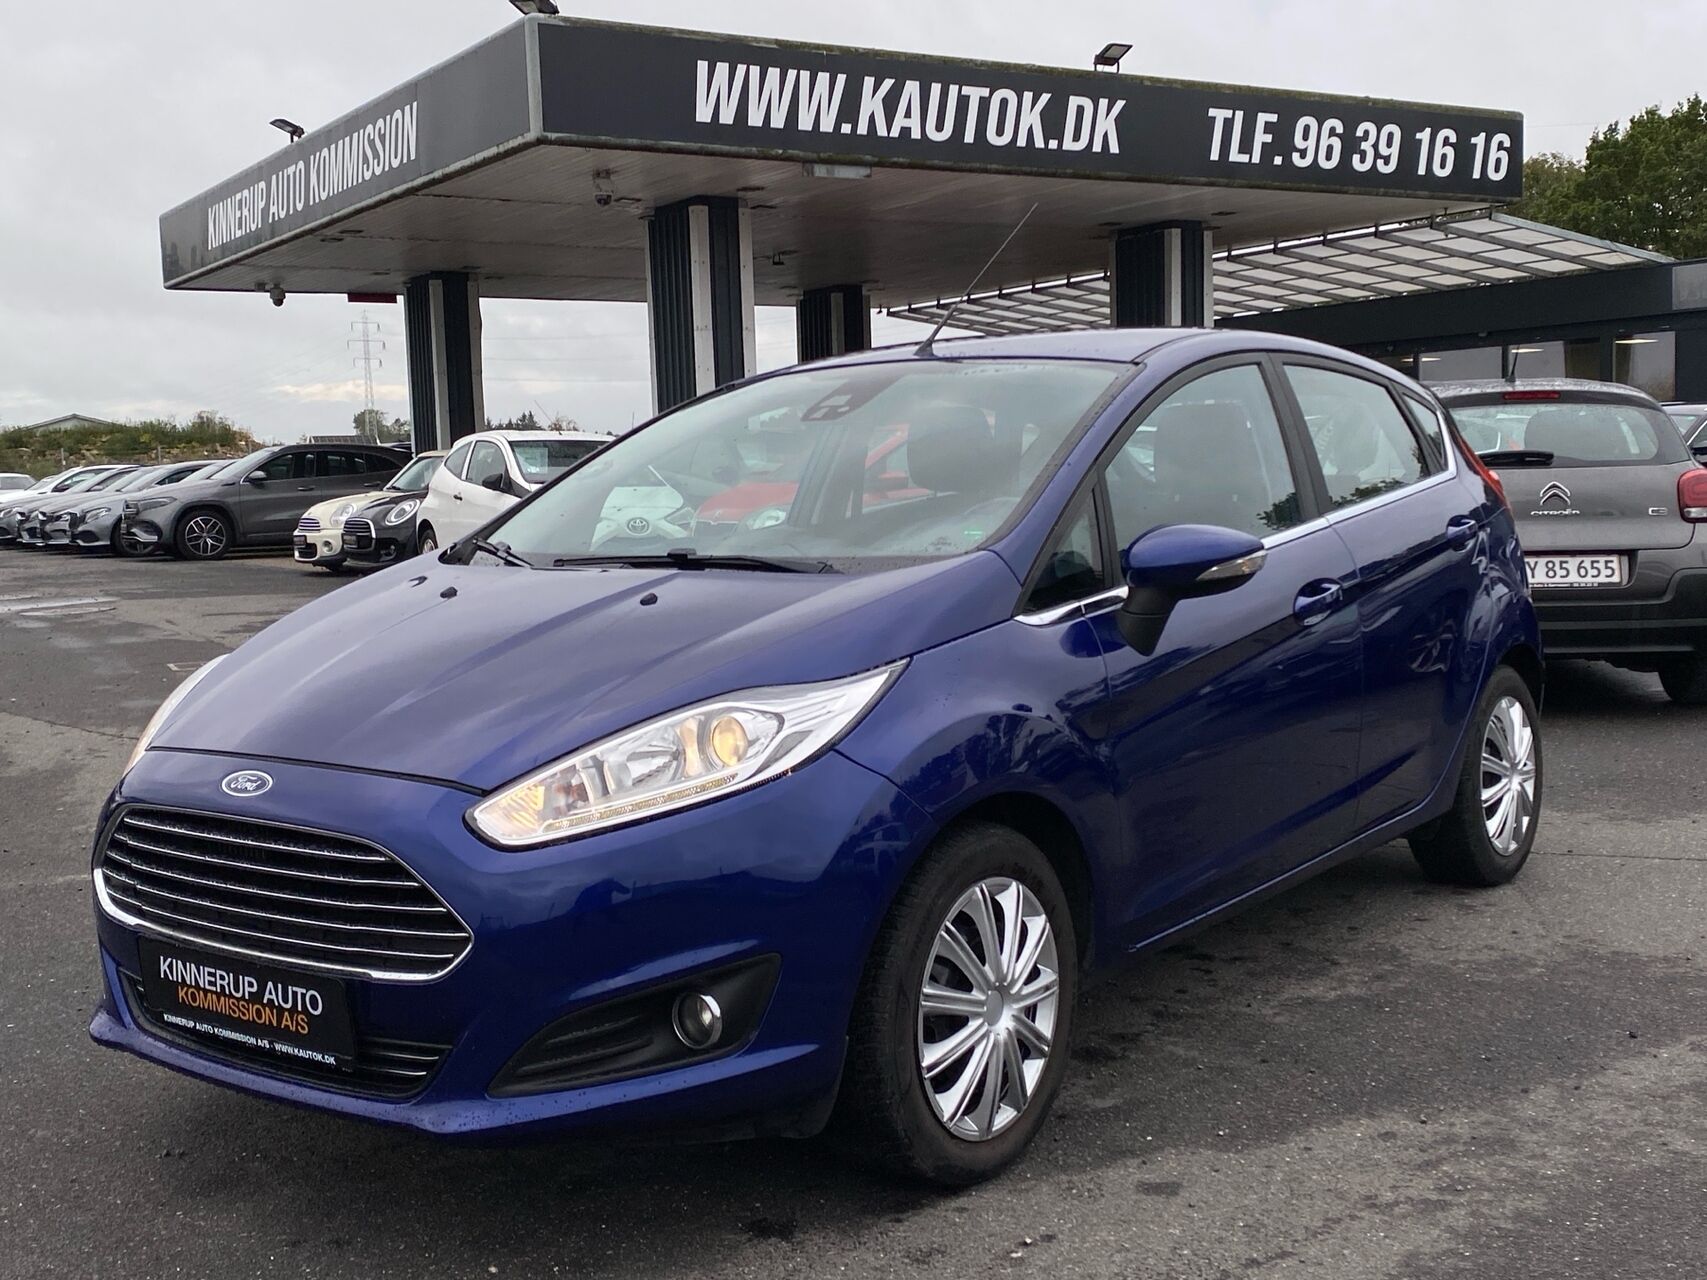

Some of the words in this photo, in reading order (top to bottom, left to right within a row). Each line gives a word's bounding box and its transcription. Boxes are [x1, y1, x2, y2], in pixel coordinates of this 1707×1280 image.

[695, 60, 1127, 155] WWW.KAUTOK.DK
[1208, 107, 1283, 166] TLF.
[1292, 115, 1344, 170] 96
[1352, 121, 1402, 174] 39
[1416, 127, 1457, 178] 16
[1470, 132, 1511, 182] 16
[207, 180, 266, 250] KINNERUP
[268, 160, 304, 223] AUTO
[309, 101, 418, 205] KOMMISSION
[1525, 560, 1538, 579] Y
[1545, 560, 1570, 578] 85
[1576, 560, 1616, 579] 655
[230, 775, 261, 791] Ford
[160, 956, 258, 1000] KINNERUP
[263, 981, 323, 1016] AUTO
[178, 985, 278, 1027] KOMMISSION
[281, 1013, 309, 1035] A/S
[163, 1013, 195, 1029] KINNERUP
[196, 1022, 214, 1034] AUTO
[214, 1027, 257, 1046] KOMMISSION
[274, 1042, 337, 1066] WWW.KAUTOK.DK
